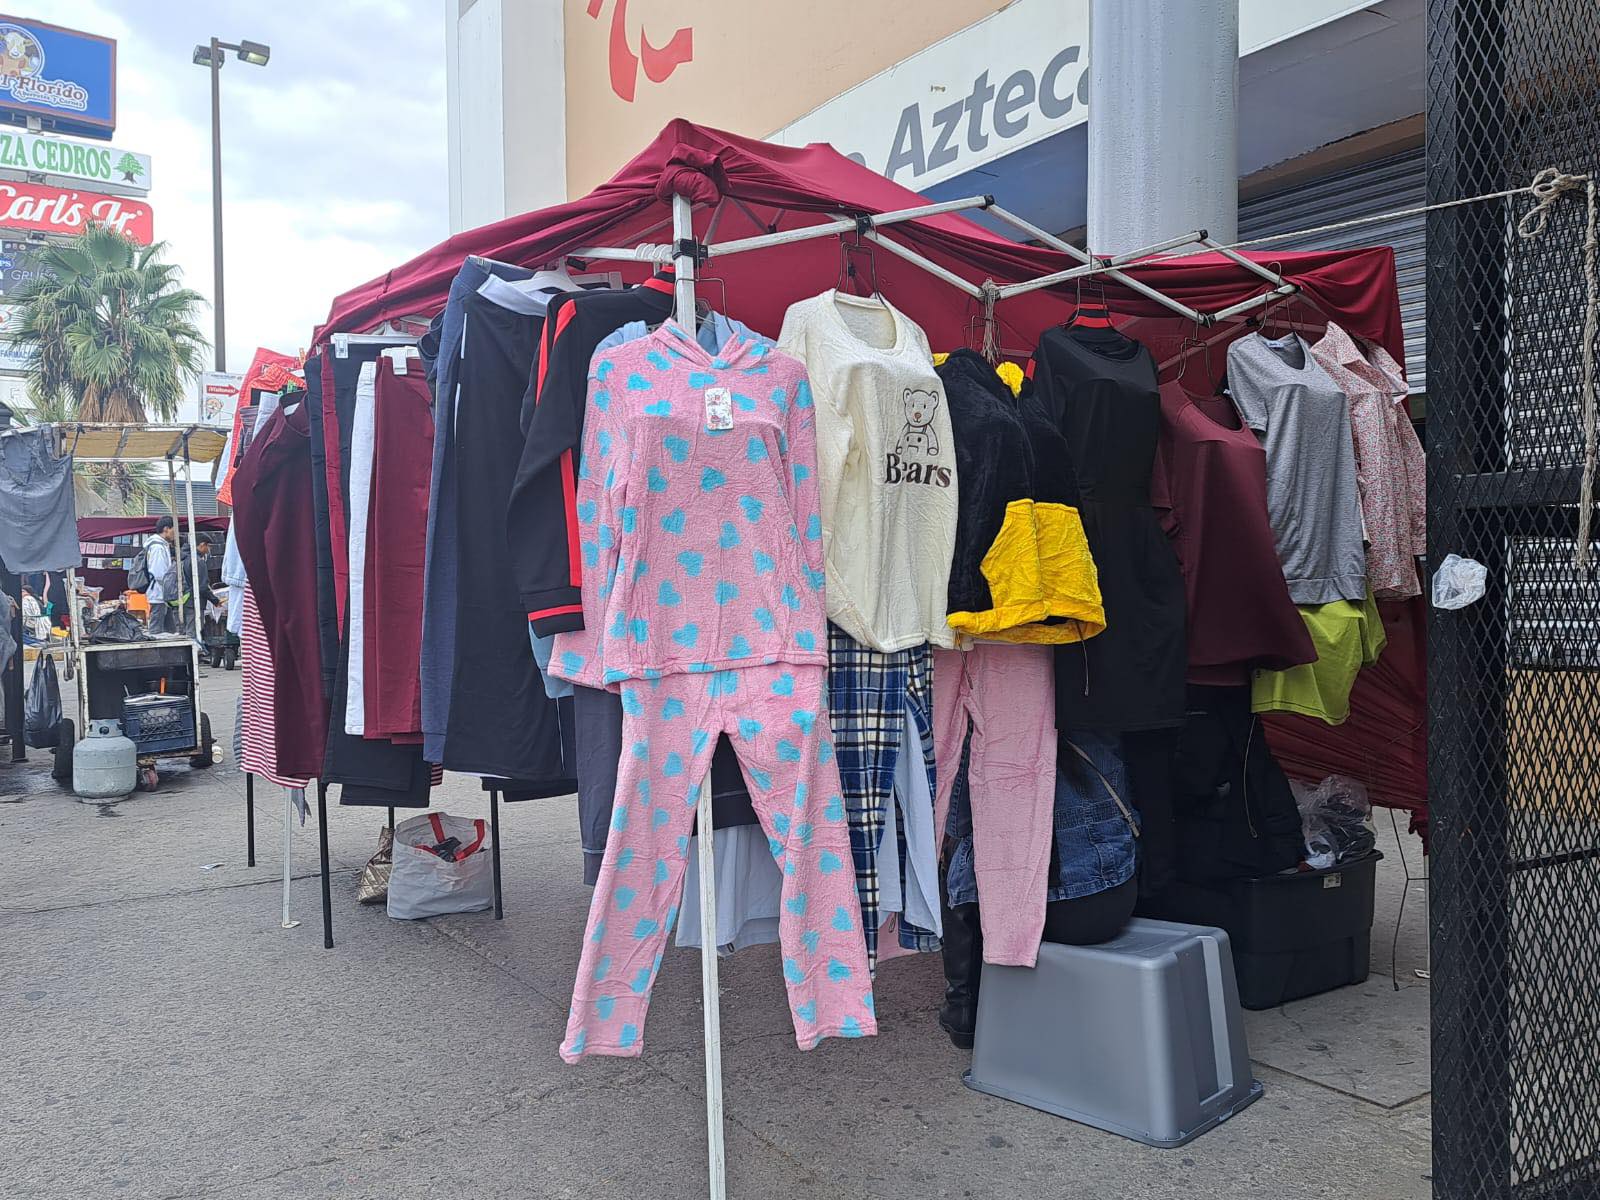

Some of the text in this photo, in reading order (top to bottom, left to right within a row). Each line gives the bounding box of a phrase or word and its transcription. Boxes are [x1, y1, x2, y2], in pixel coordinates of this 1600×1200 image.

[17, 76, 84, 101] Florido
[32, 139, 112, 179] CEDROS
[884, 452, 952, 488] Bears
